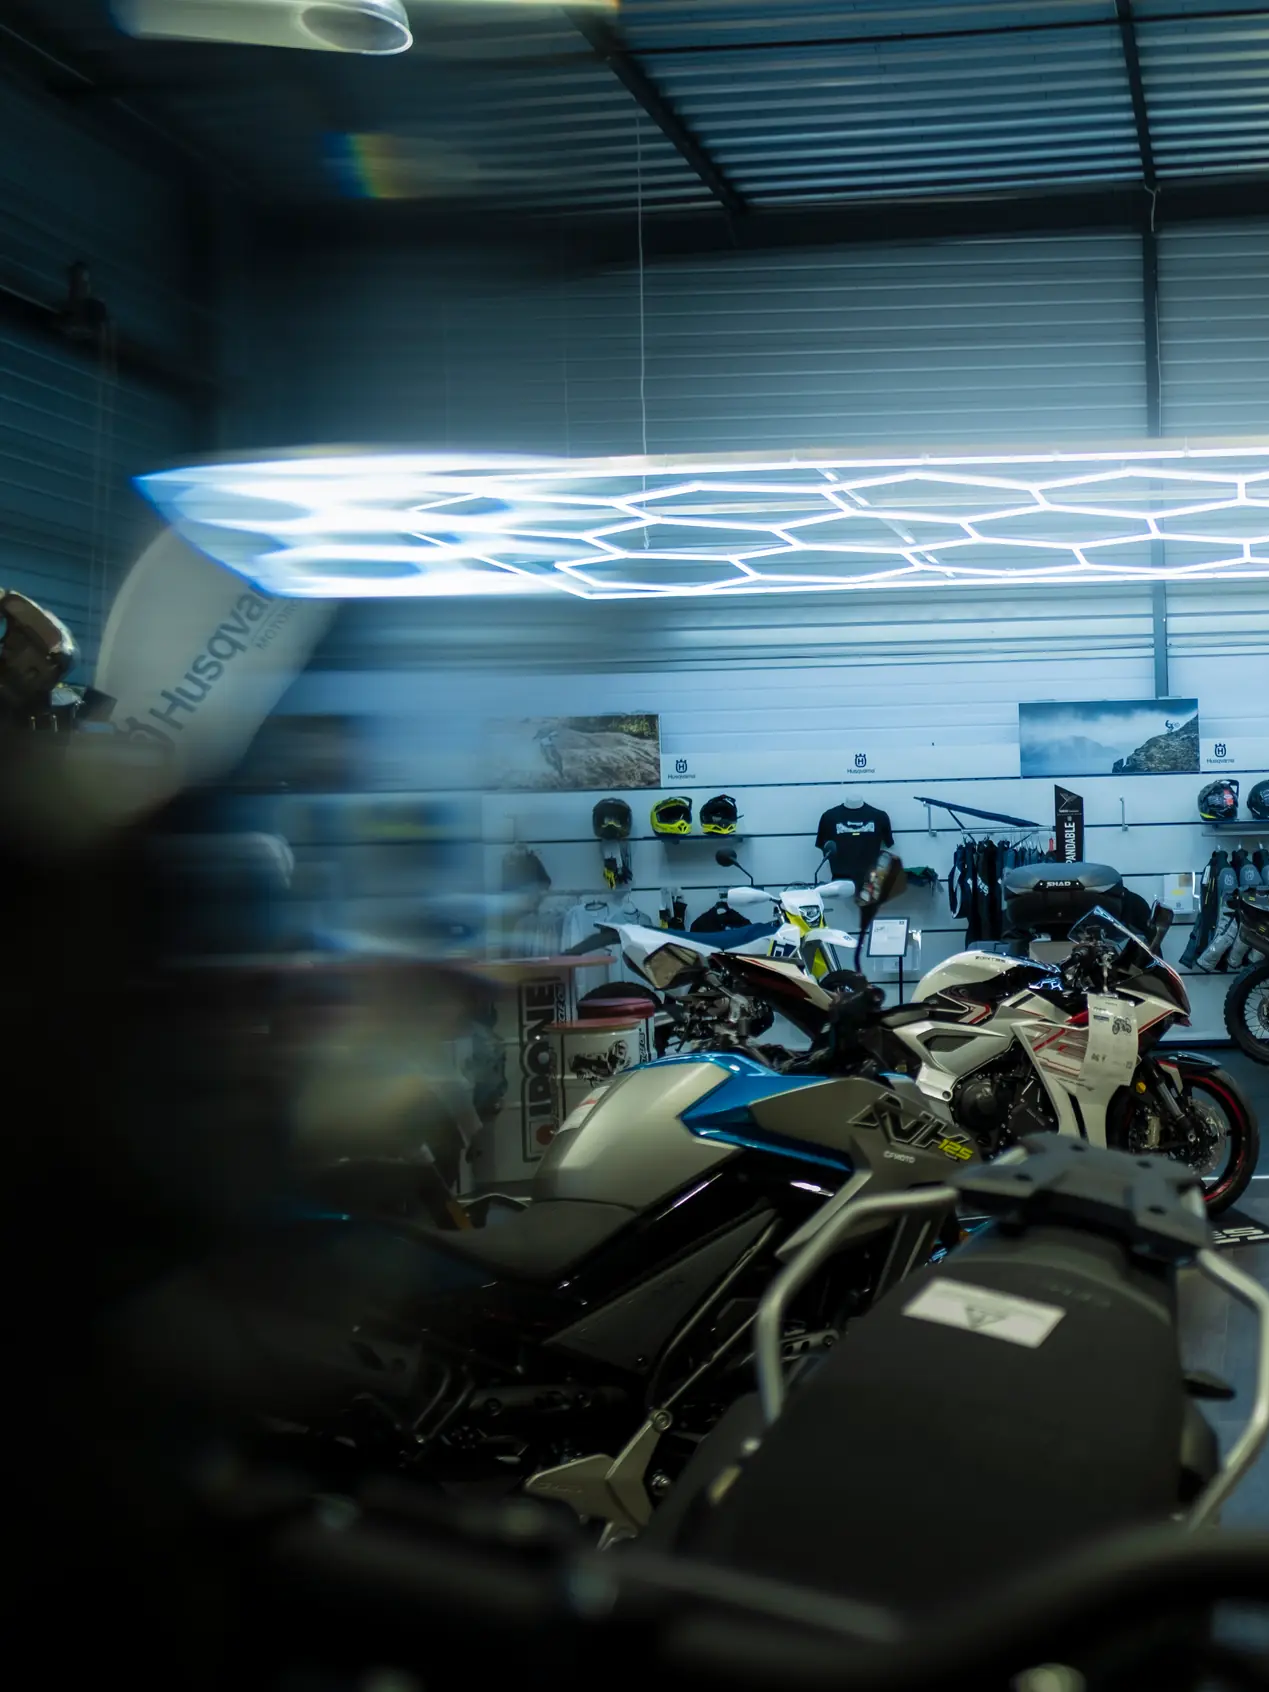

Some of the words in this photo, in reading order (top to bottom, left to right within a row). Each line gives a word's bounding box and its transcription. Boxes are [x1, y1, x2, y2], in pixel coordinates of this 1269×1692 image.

[847, 767, 875, 775] Husqvarna
[883, 1150, 916, 1163] CFMOTO
[937, 1139, 975, 1161] 125
